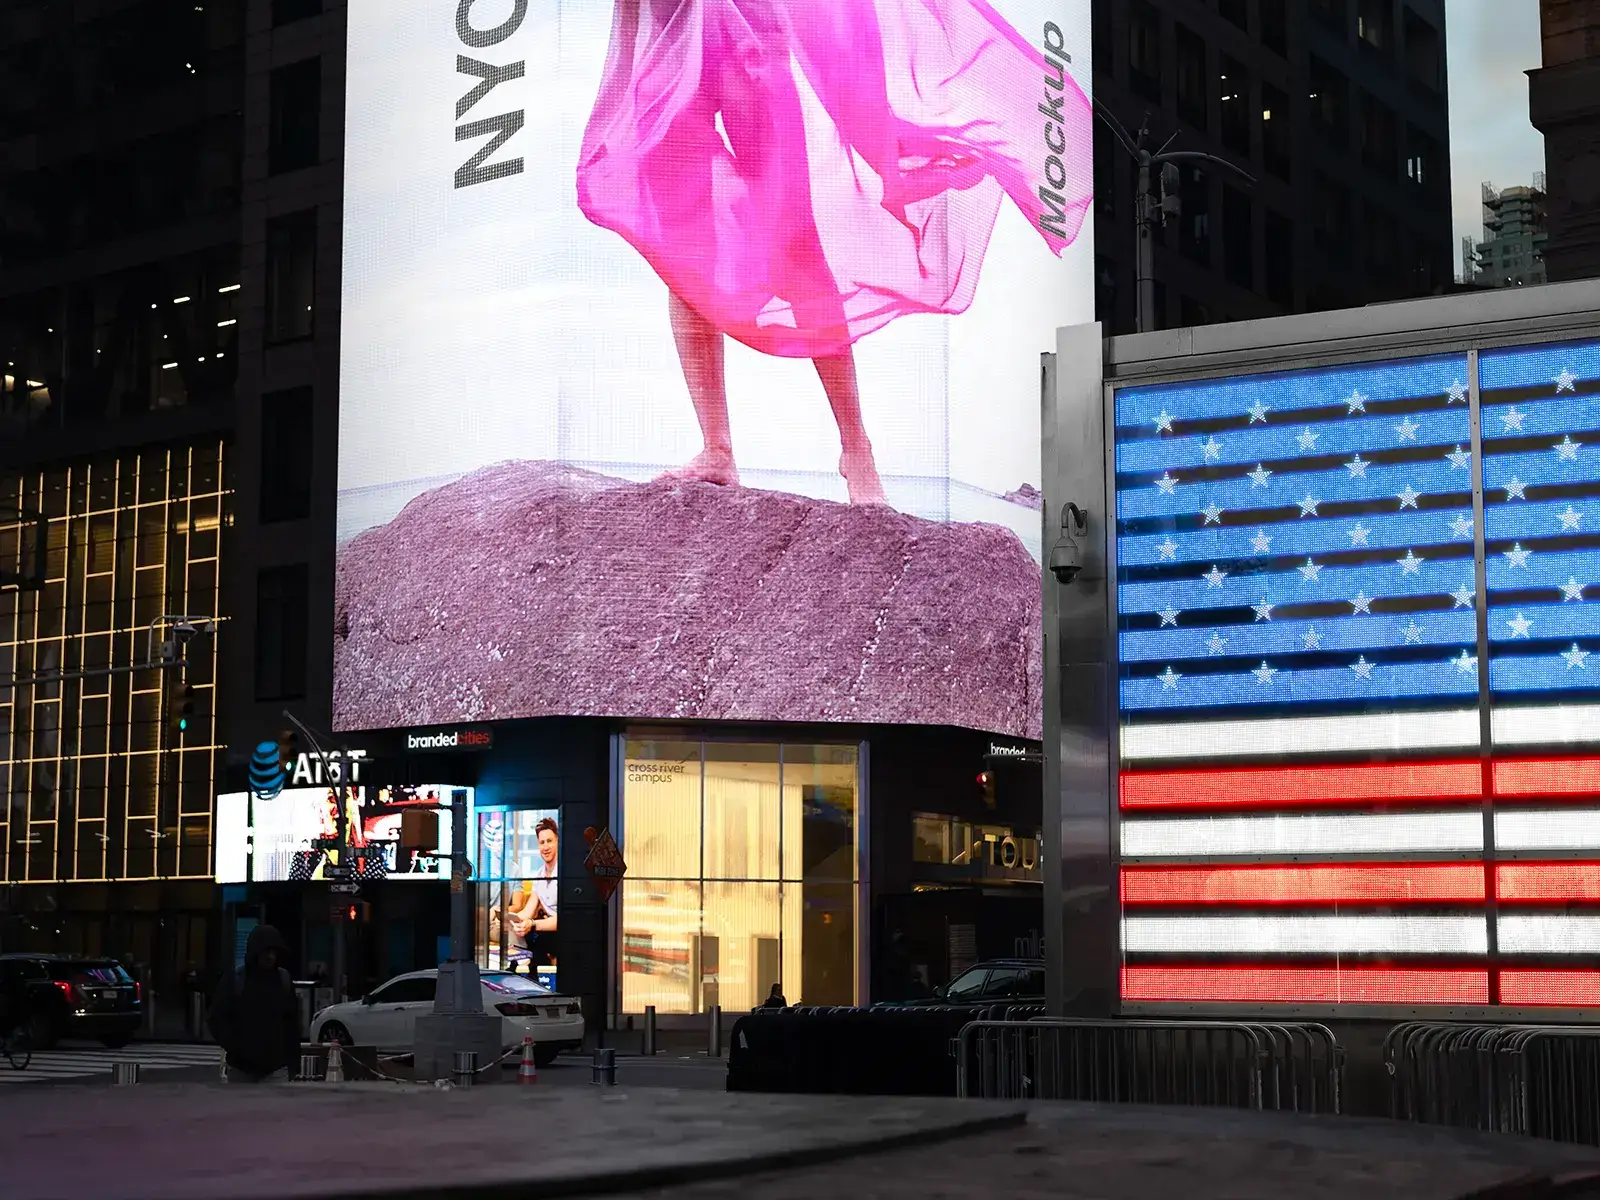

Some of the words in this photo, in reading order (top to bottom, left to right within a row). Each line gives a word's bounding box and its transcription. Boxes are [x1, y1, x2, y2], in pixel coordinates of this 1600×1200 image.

[1037, 20, 1072, 240] Mockup
[292, 749, 367, 785] AT&T
[628, 763, 658, 773] cross
[660, 762, 685, 774] river
[628, 773, 673, 785] campus
